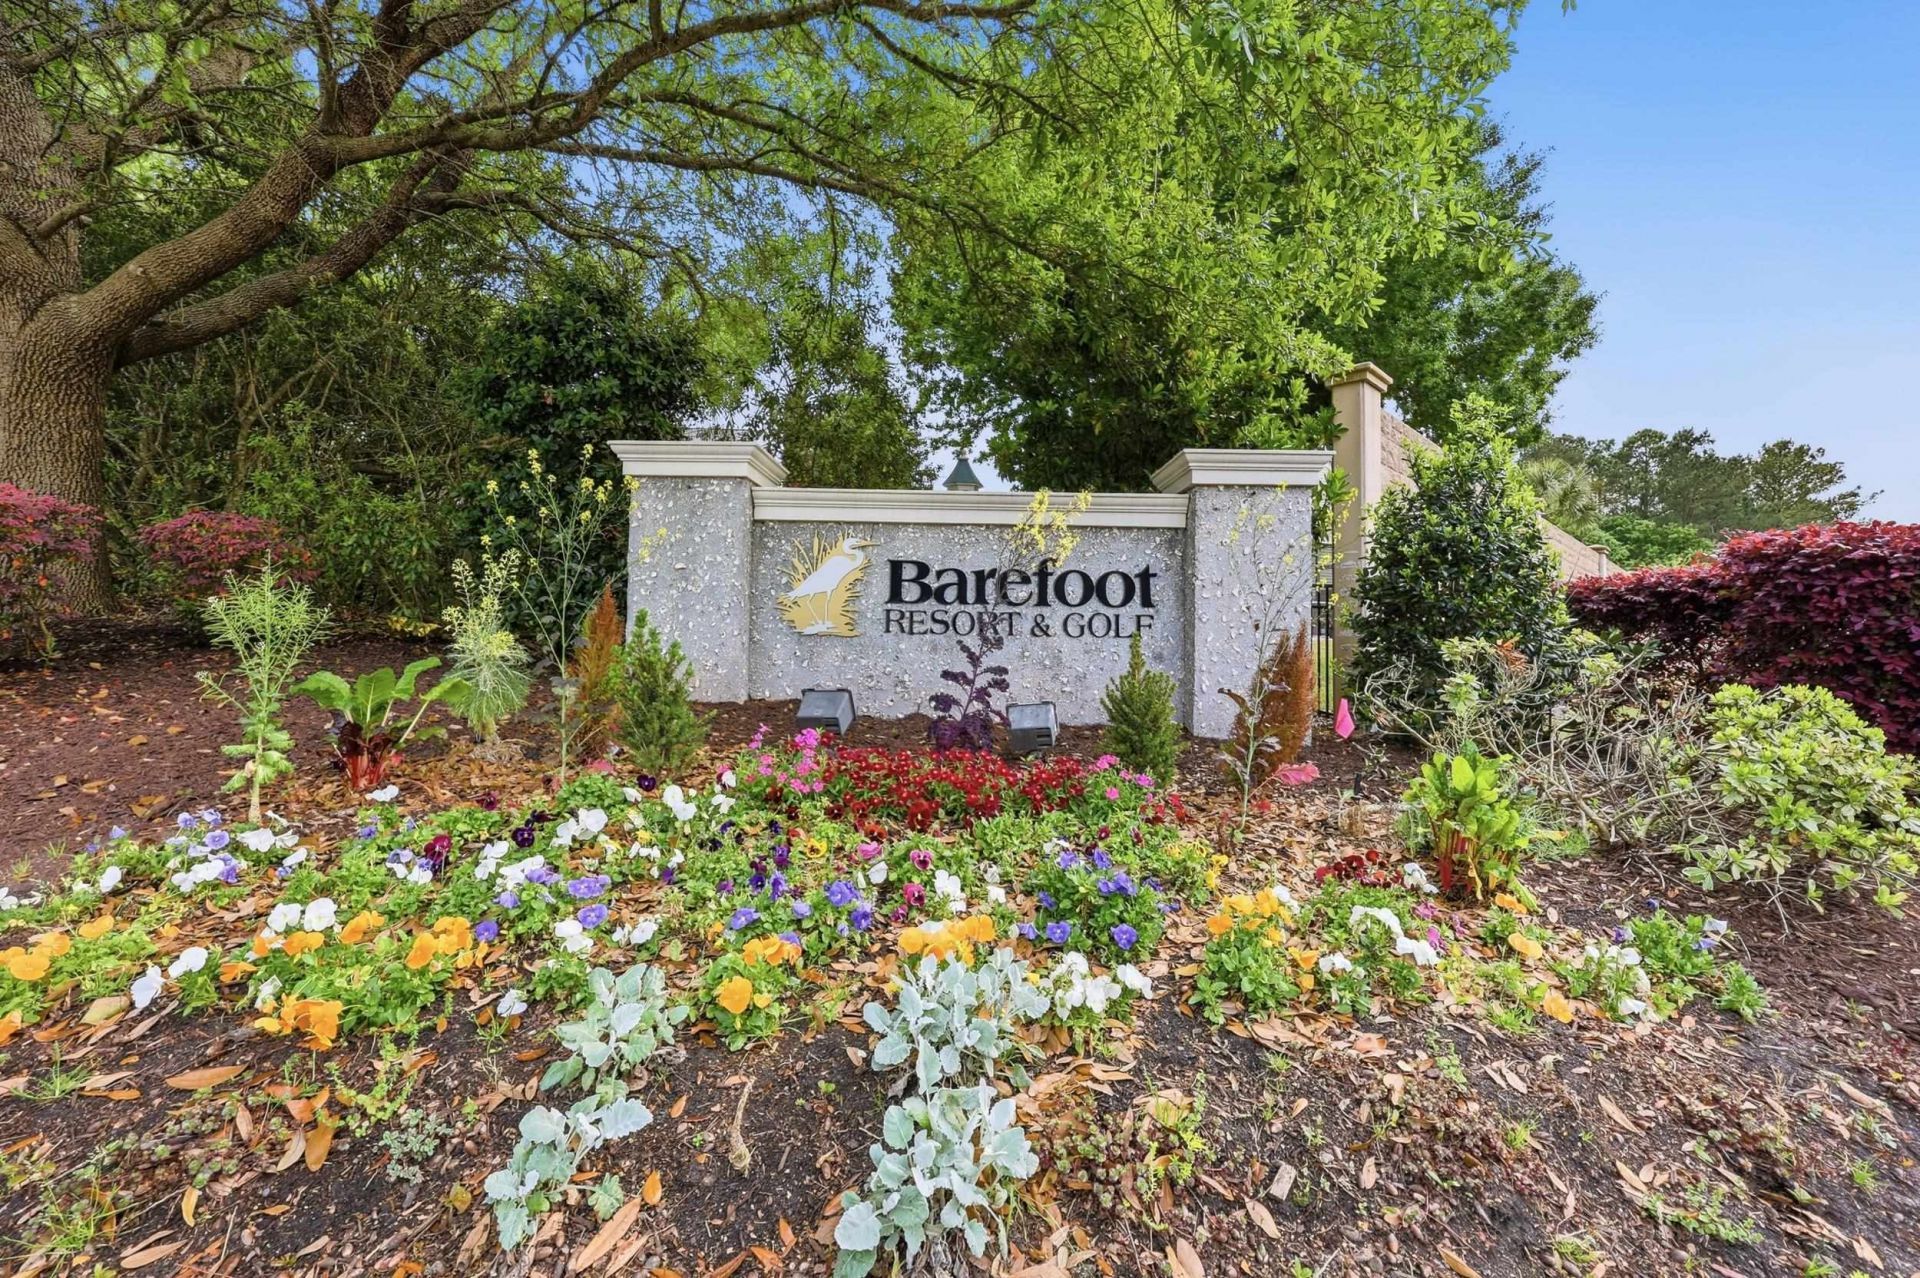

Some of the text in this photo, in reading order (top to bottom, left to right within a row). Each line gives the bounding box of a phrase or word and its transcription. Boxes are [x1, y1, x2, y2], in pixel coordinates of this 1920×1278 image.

[884, 557, 1158, 608] Barefoot
[884, 608, 1155, 638] RESORT & GOLF
